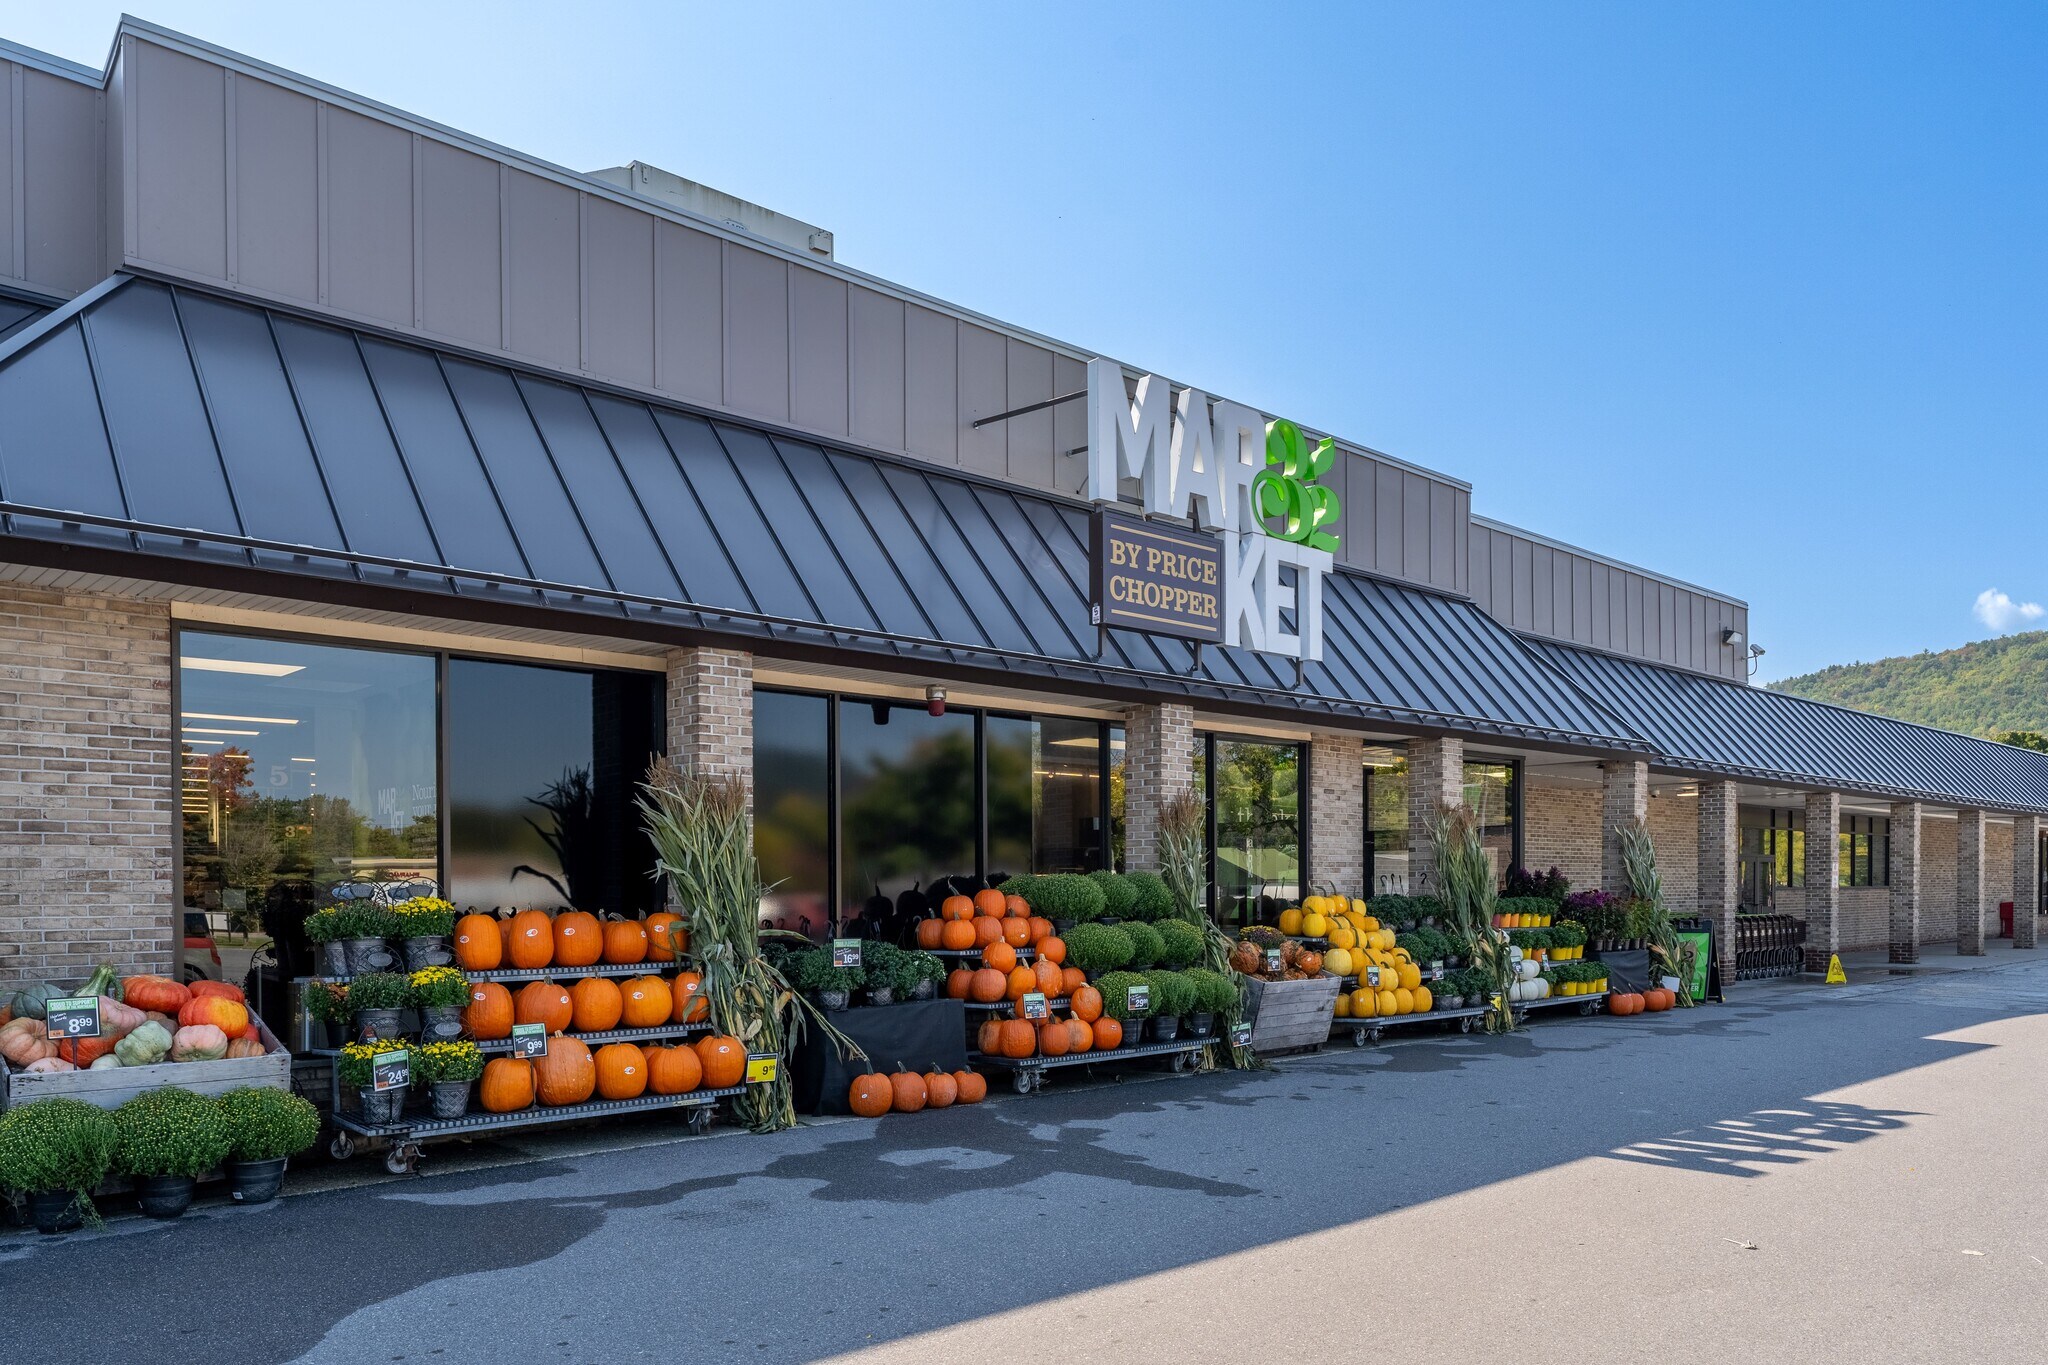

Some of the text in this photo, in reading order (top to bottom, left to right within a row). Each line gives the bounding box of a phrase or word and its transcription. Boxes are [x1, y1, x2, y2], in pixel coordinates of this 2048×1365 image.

[1110, 538, 1218, 586] BY PRICE
[1109, 575, 1218, 620] CHOPPER
[269, 765, 289, 787] 5
[412, 783, 437, 801] Nouri
[284, 825, 296, 838] 3
